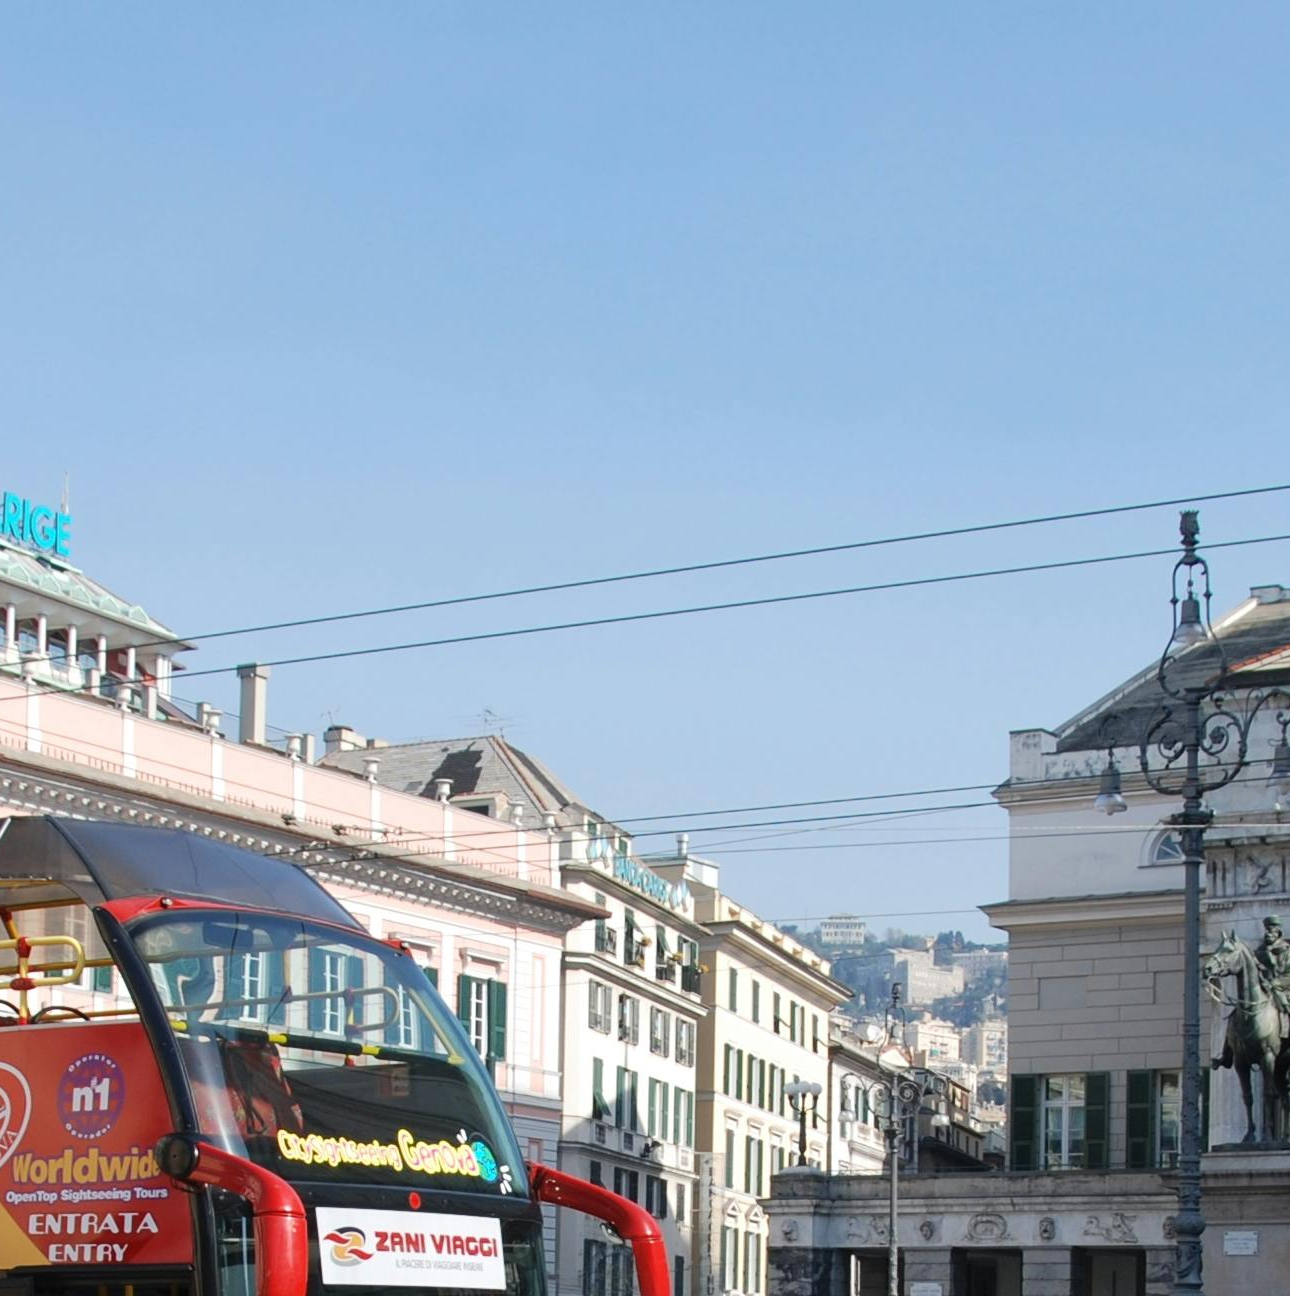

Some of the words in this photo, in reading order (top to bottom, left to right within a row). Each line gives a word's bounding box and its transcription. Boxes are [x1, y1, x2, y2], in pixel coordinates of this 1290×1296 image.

[277, 1129, 403, 1171] CitySightseeing
[397, 1128, 480, 1176] Genova
[6, 1190, 57, 1204] OpenTop
[61, 1188, 131, 1202] Sightseeing
[134, 1187, 168, 1199] Tours
[28, 1213, 159, 1235] ENTRATA
[49, 1243, 128, 1262] ENTRY
[375, 1231, 427, 1254] ZANI
[429, 1234, 499, 1258] VIAGGI
